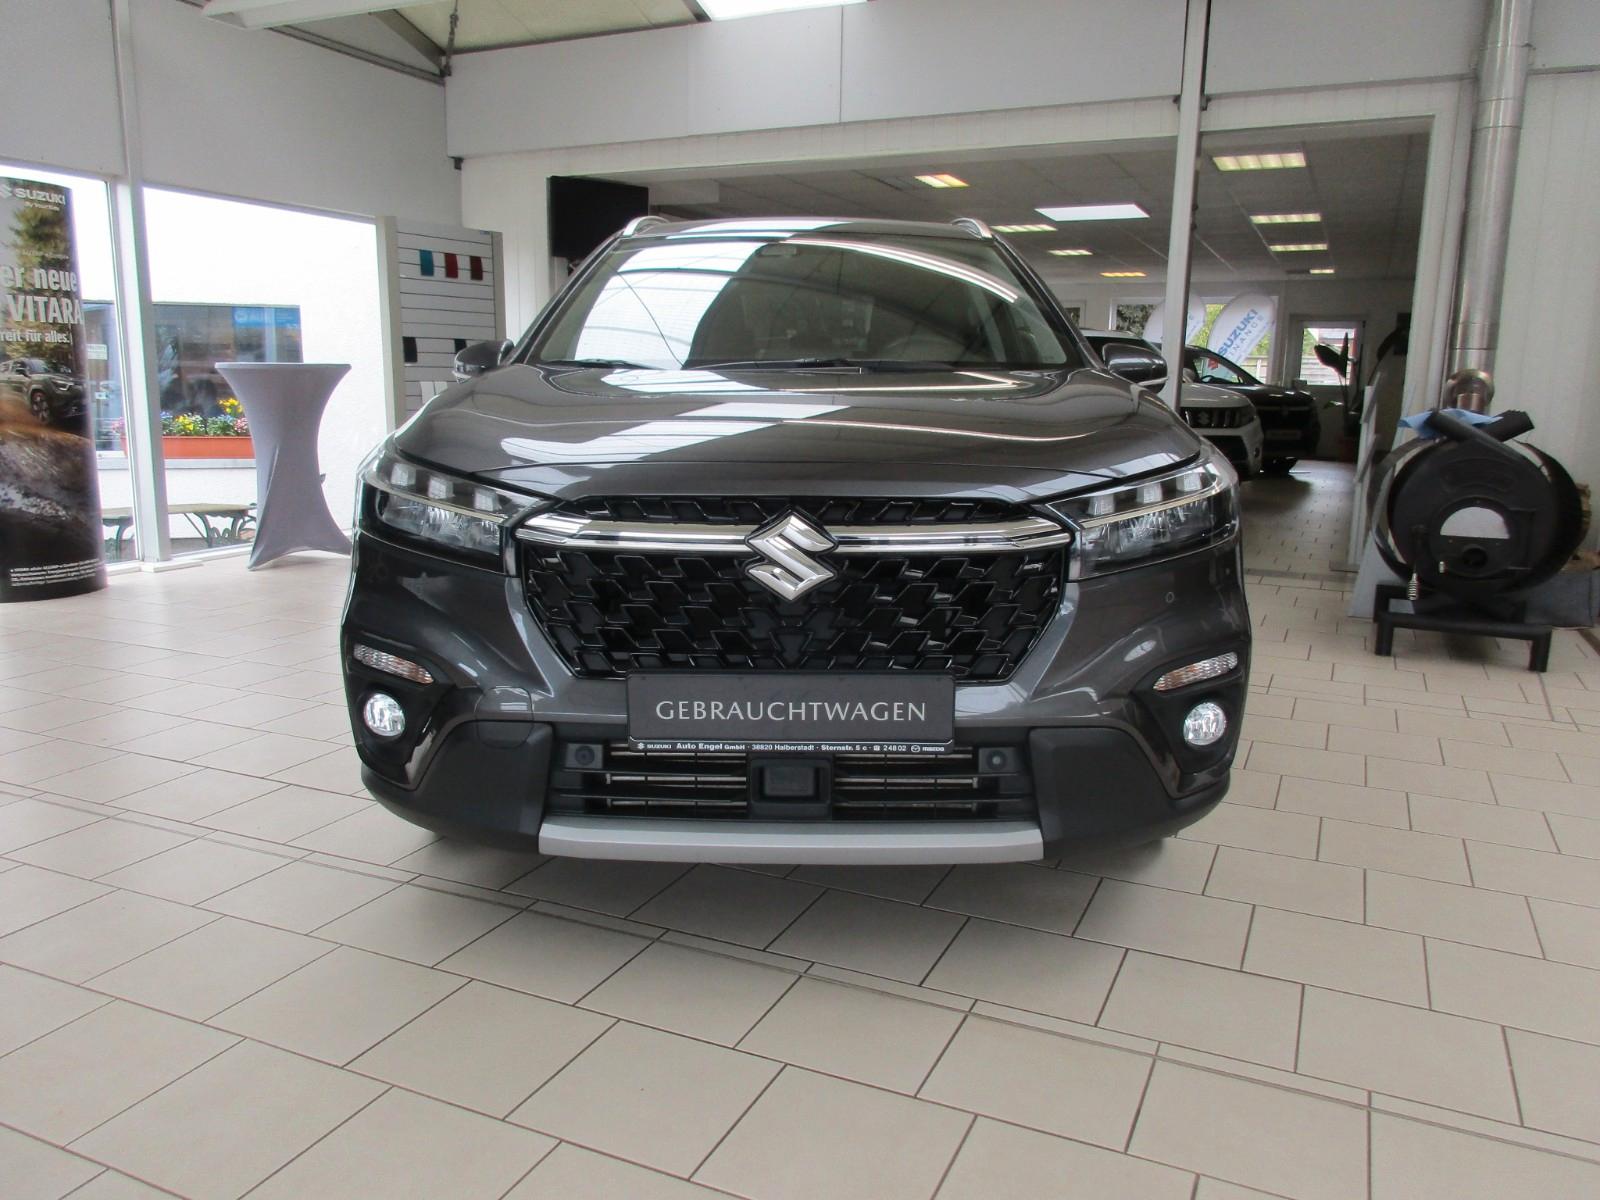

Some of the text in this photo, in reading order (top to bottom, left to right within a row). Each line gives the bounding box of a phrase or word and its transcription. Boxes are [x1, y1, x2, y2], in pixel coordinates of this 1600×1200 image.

[15, 187, 66, 205] SUZUKI
[33, 268, 78, 291] neue
[5, 294, 85, 325] VITARA
[25, 329, 42, 342] für
[1217, 309, 1258, 356] SUZUKI
[656, 701, 926, 721] GEBRAUCHTWAGEN
[698, 743, 723, 751] Engel
